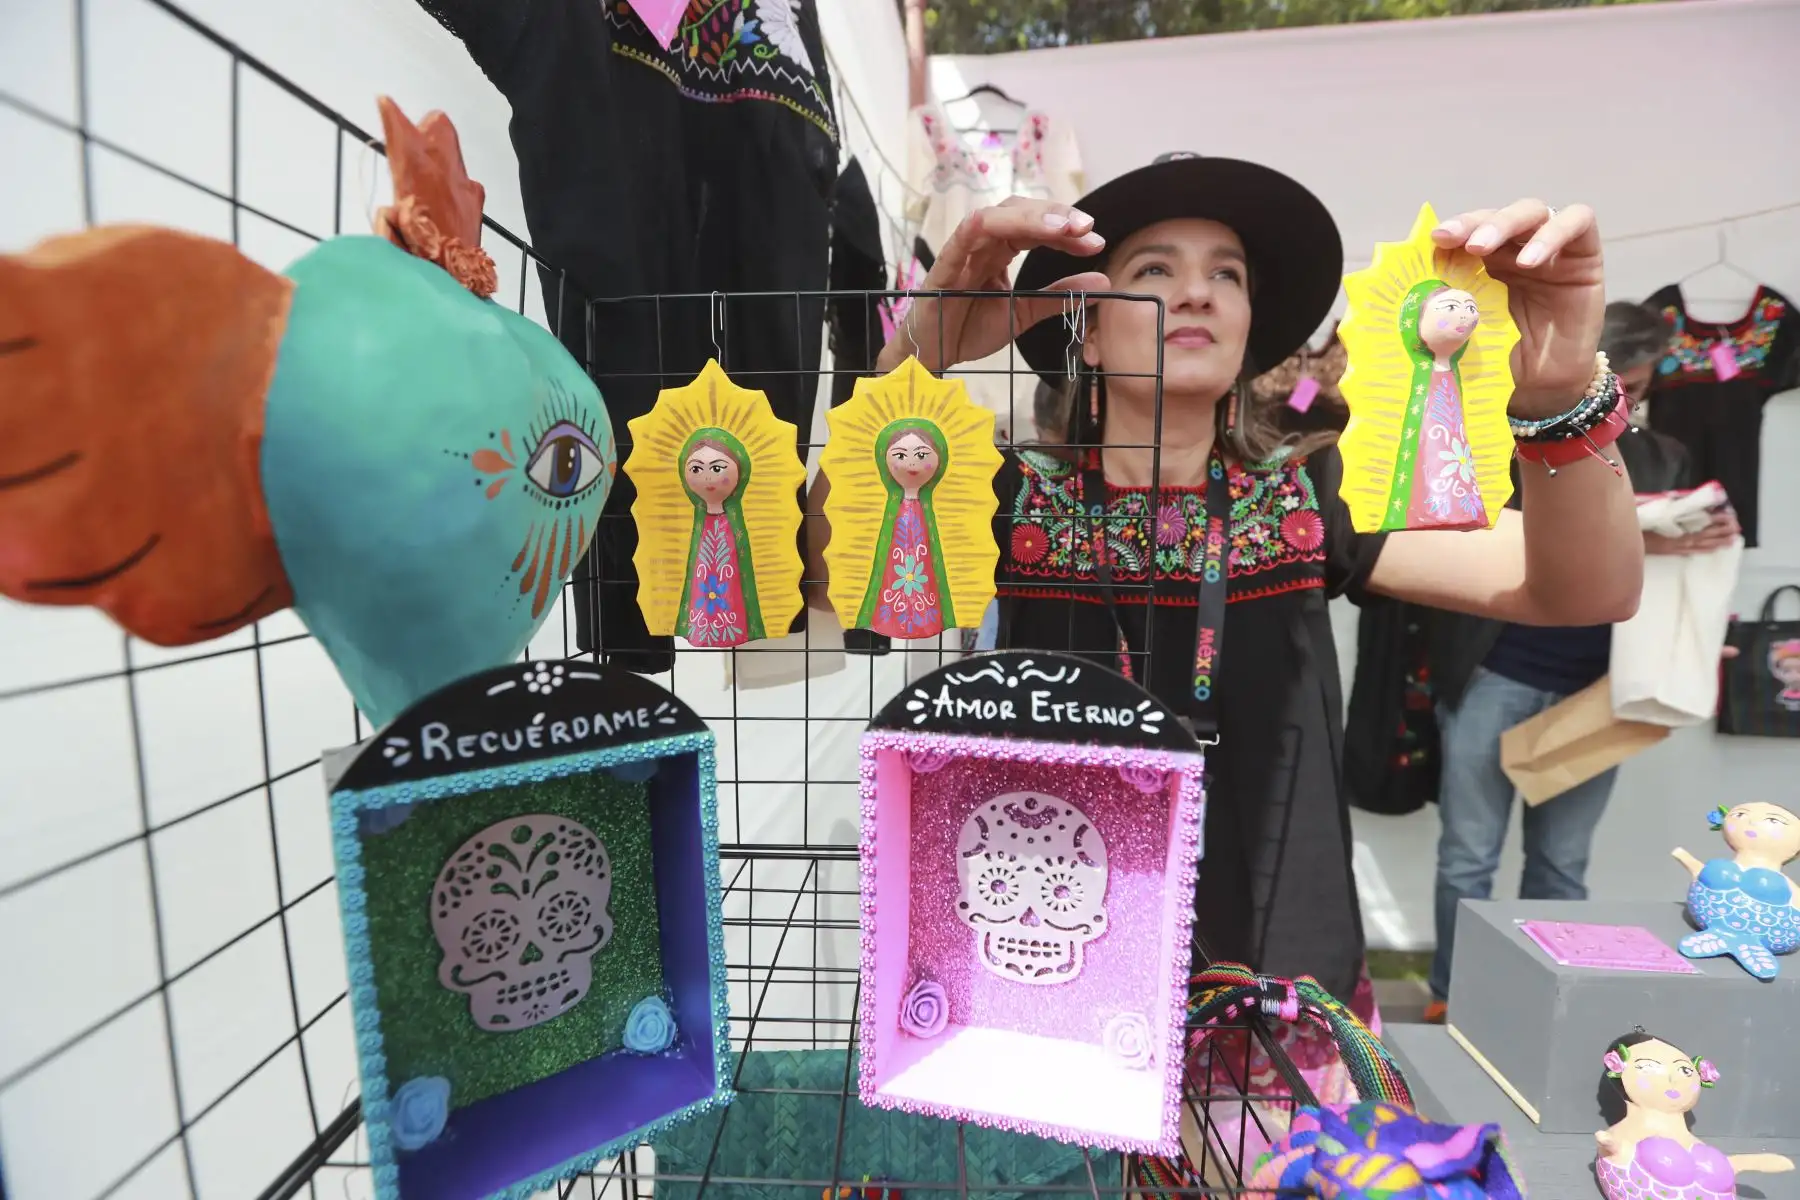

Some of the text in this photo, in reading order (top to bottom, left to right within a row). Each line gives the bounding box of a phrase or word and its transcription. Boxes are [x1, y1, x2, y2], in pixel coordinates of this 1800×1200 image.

[932, 684, 1136, 728] AMOR ETERNO
[421, 707, 651, 762] RECUÉRDAME
